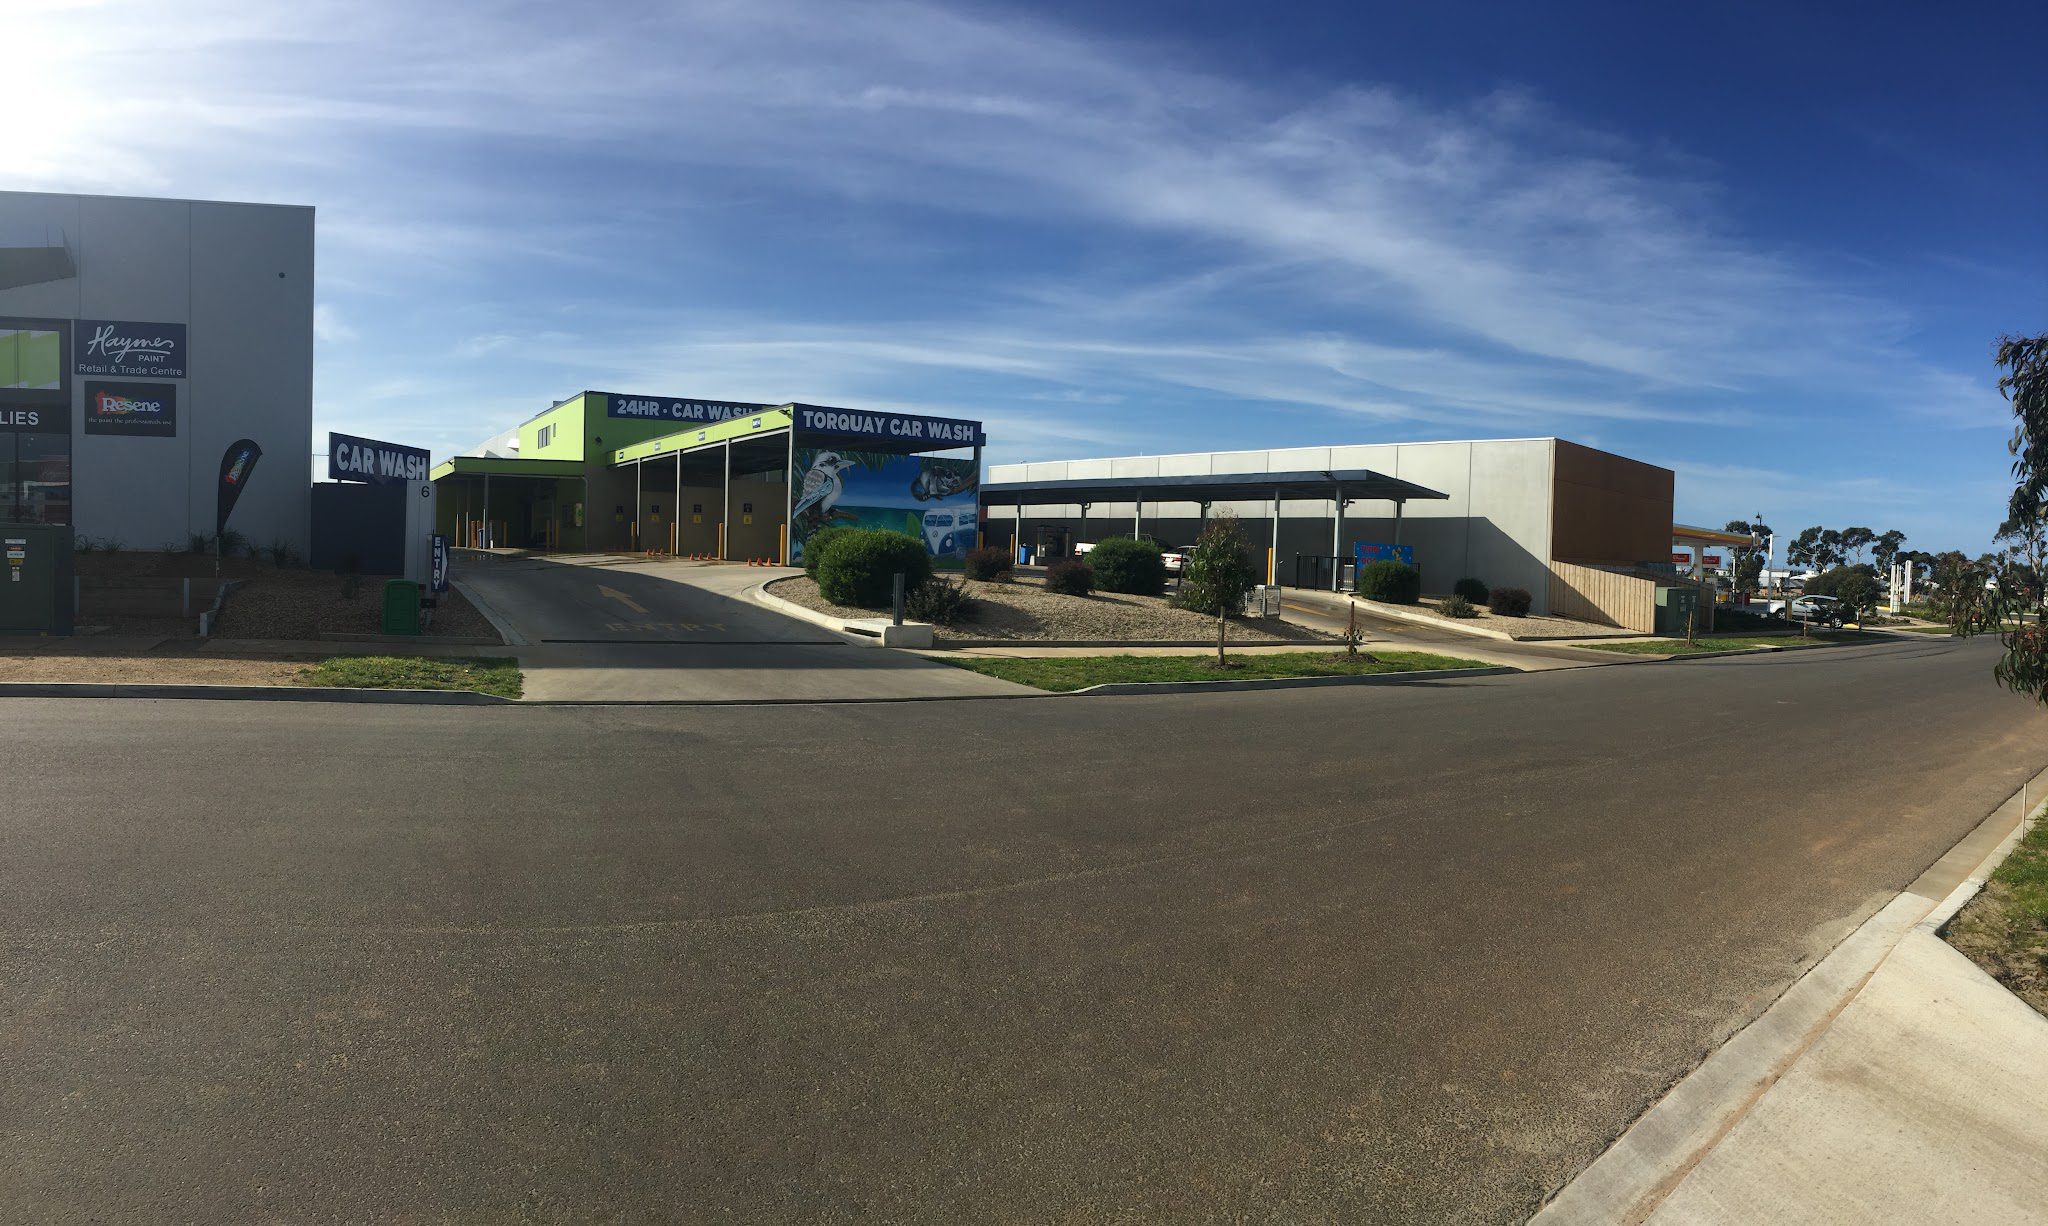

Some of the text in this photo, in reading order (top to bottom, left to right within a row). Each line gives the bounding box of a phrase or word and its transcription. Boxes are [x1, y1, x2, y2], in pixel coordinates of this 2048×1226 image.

[87, 325, 175, 363] Haymes
[138, 354, 166, 363] PAINT
[79, 364, 107, 373] Retail
[120, 366, 148, 375] Trade
[150, 367, 183, 376] Centre
[101, 397, 161, 412] Resene
[617, 400, 660, 417] 24HR
[671, 402, 704, 419] CAR
[0, 411, 39, 426] LIES
[803, 410, 974, 442] TORQUAY CAR WASH
[336, 442, 427, 481] CAR WASH
[421, 485, 430, 498] 6
[433, 536, 441, 590] ENTRY
